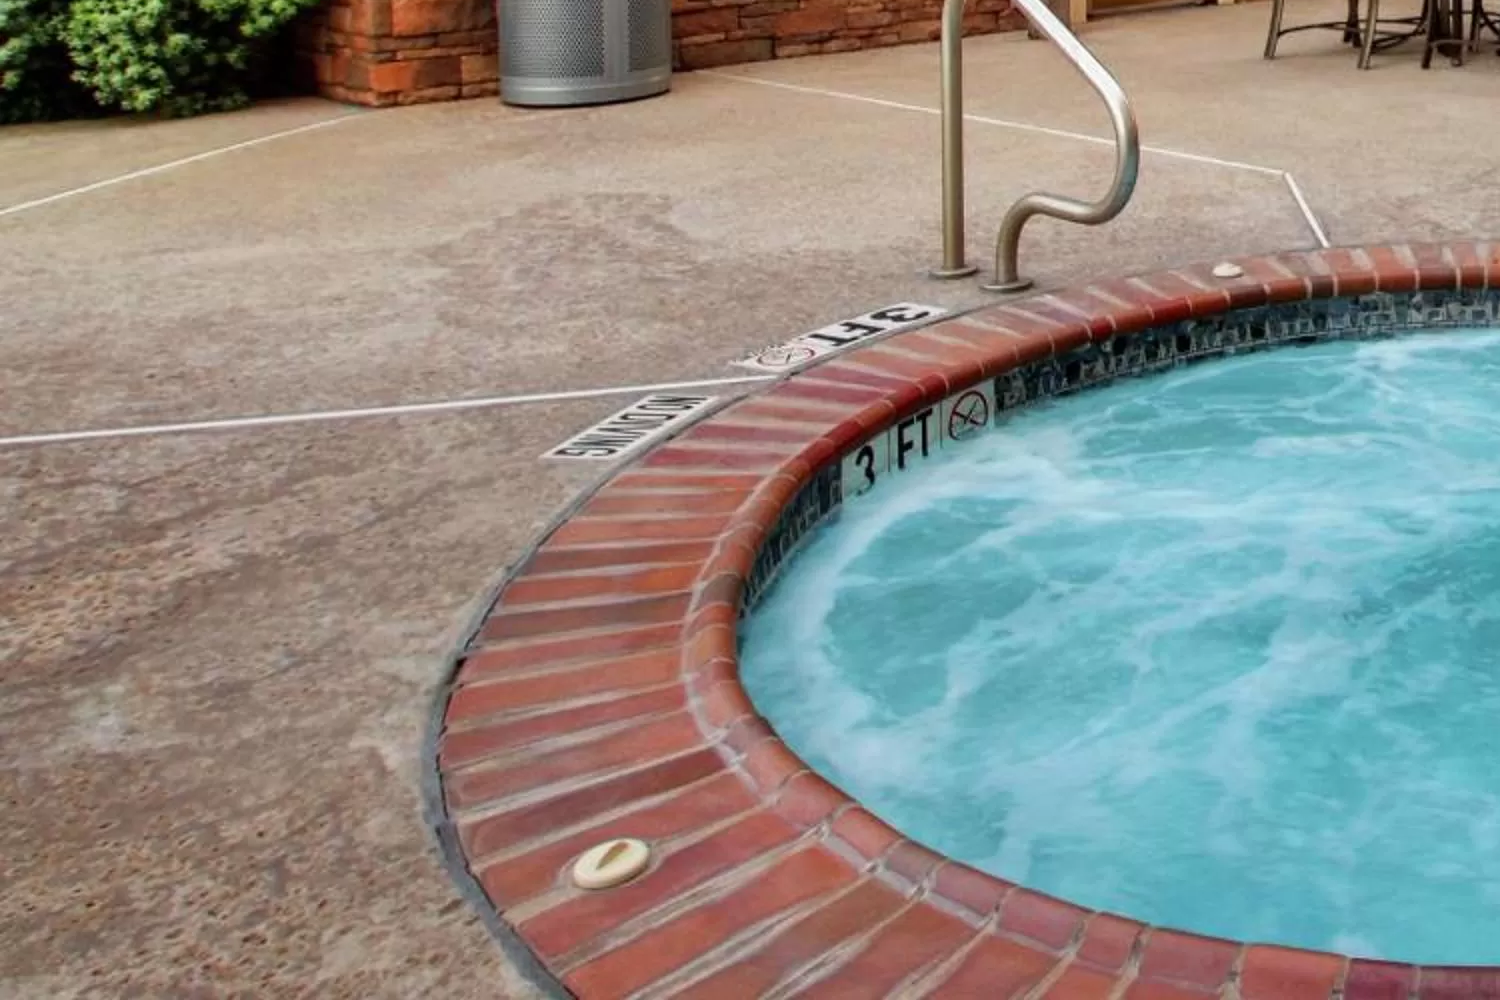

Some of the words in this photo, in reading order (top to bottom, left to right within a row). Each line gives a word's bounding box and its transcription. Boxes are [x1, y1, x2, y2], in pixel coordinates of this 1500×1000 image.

[870, 307, 932, 322] 3
[808, 322, 886, 347] FT
[637, 395, 708, 411] NO
[552, 413, 678, 457] DIVING
[855, 446, 876, 496] 3
[897, 407, 933, 471] FT
